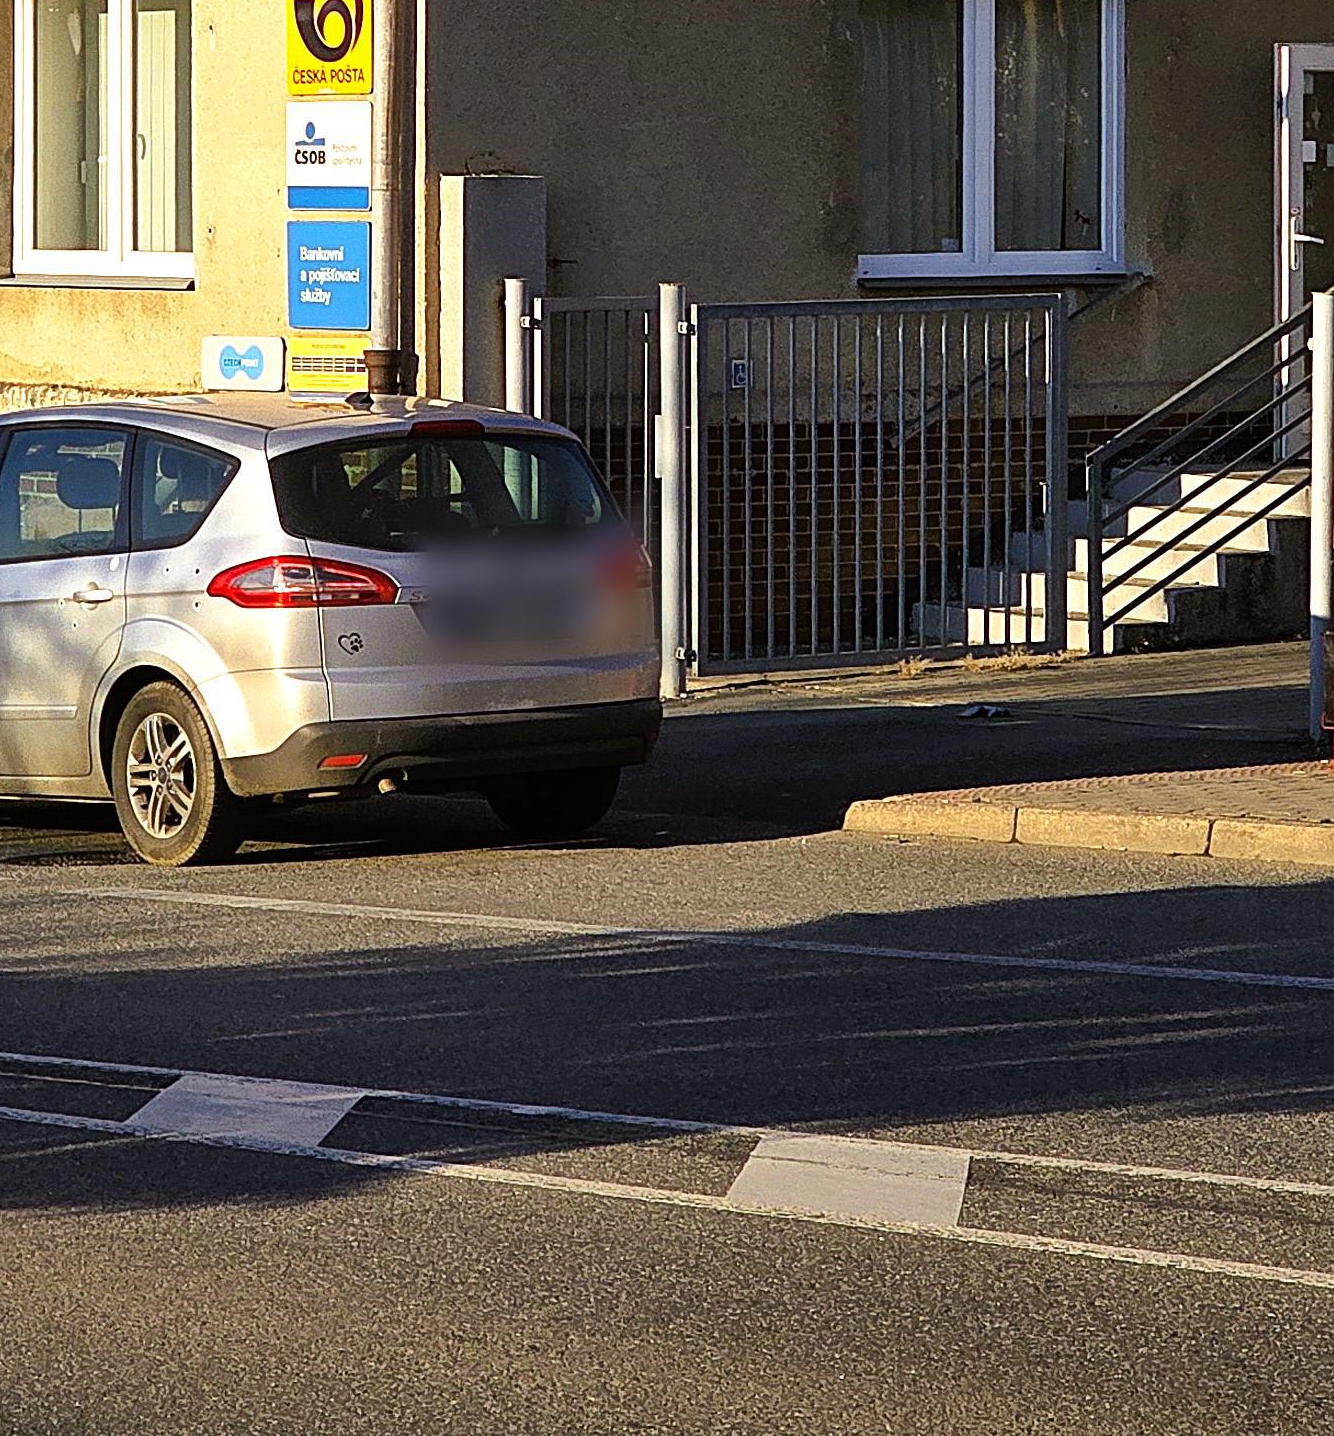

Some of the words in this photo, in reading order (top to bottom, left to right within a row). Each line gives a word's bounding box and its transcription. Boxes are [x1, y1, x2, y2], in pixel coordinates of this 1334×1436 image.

[292, 66, 327, 85] ČESKÁ
[330, 65, 365, 84] POŠTA
[294, 149, 326, 165] ČSOB
[299, 245, 345, 261] Bankovní
[300, 270, 307, 282] a
[308, 267, 360, 285] pojišťovací
[300, 287, 332, 306] služby
